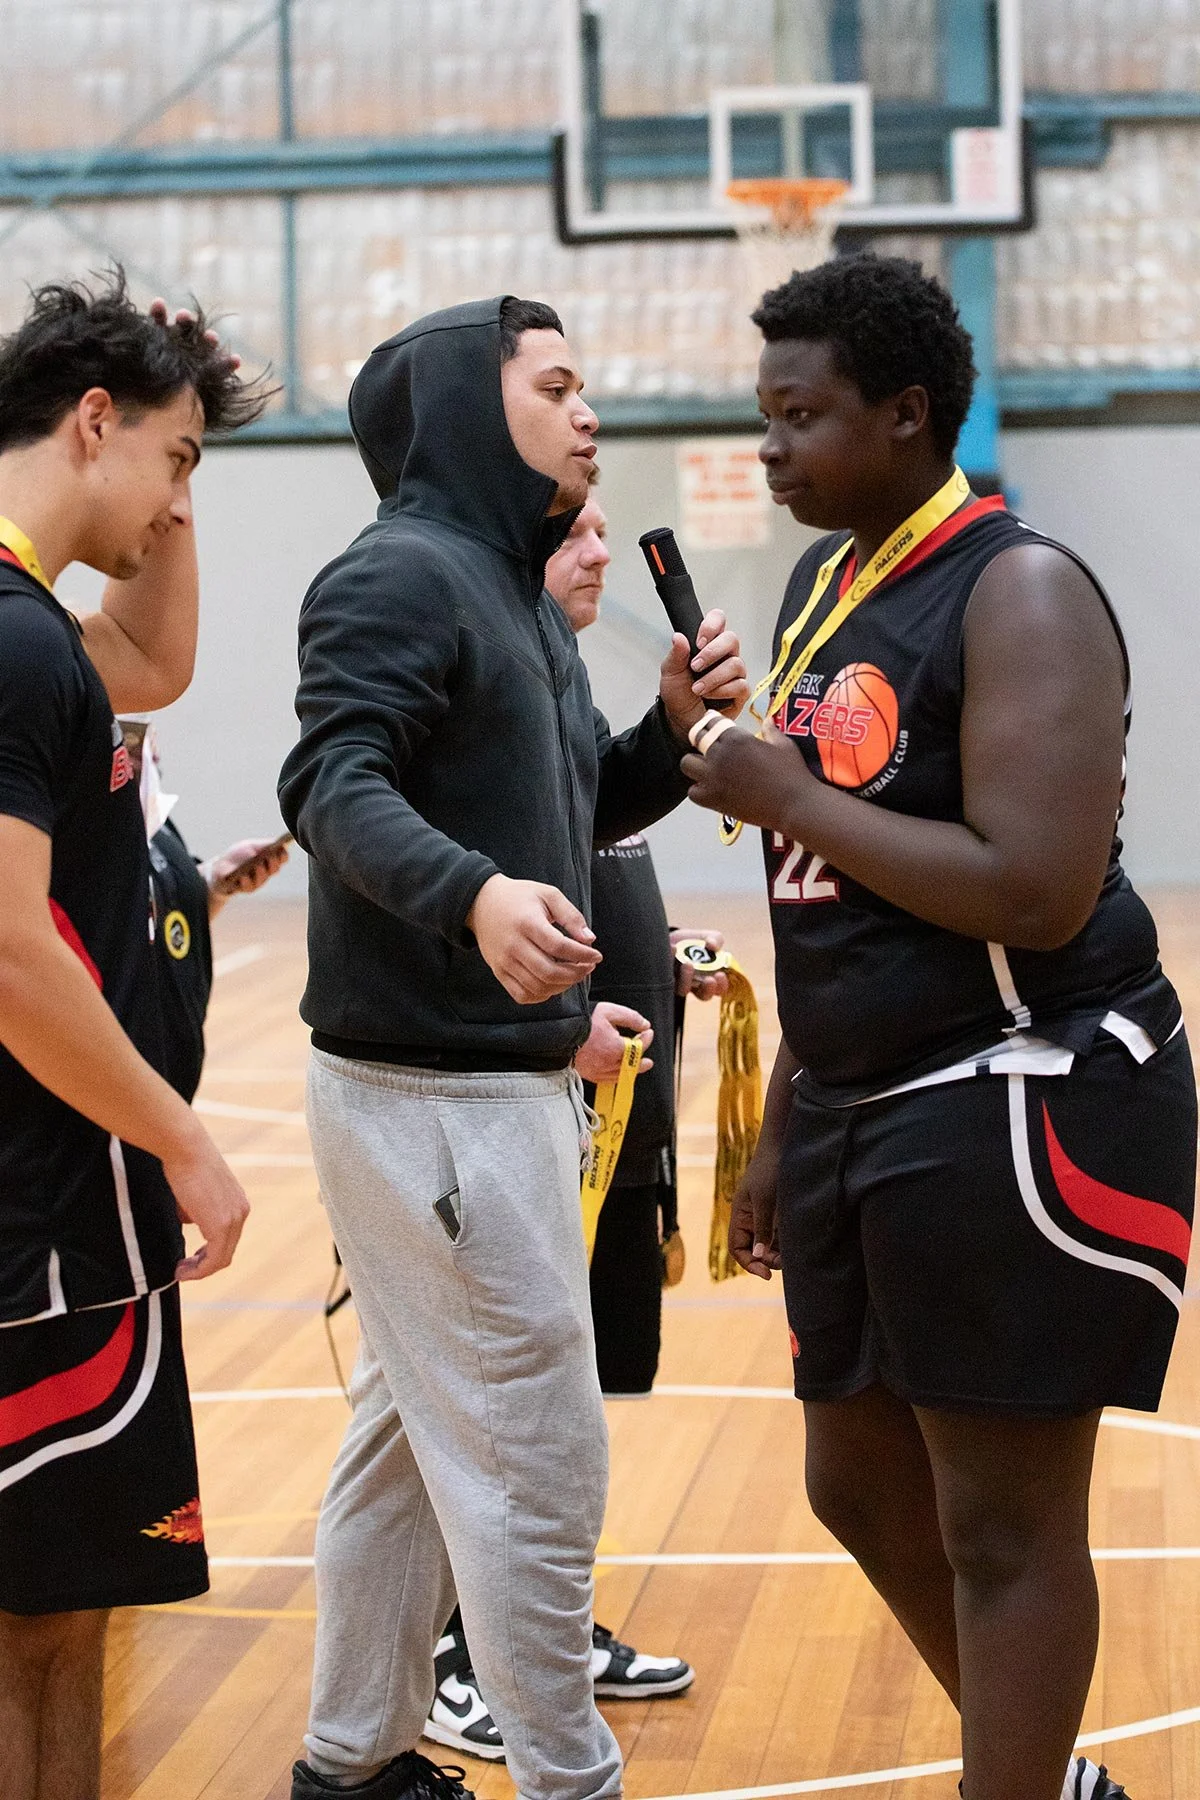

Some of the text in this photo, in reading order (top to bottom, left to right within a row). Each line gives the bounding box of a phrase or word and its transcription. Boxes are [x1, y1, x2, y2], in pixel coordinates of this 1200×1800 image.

[874, 529, 914, 575] PACERS
[769, 698, 875, 746] AZERS
[862, 730, 909, 798] ETBALL CLUB
[771, 828, 840, 904] 22
